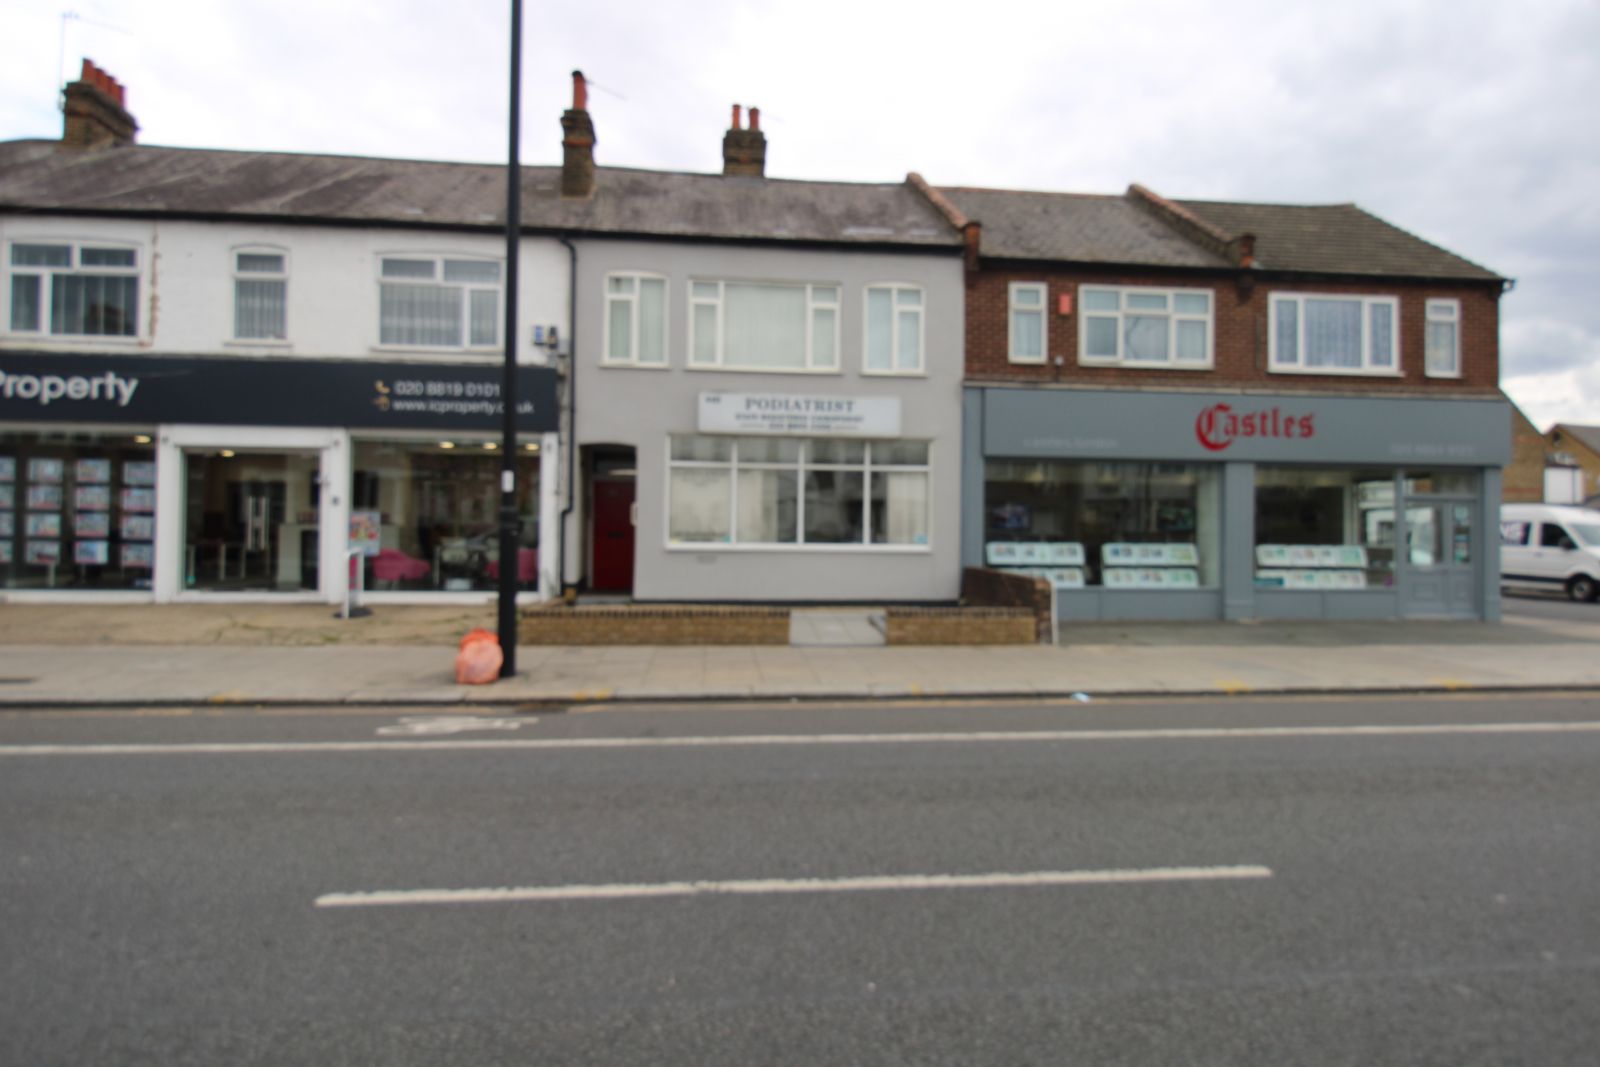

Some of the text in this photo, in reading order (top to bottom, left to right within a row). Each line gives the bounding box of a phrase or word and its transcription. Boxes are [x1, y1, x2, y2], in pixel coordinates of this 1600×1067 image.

[394, 380, 424, 396] 020
[465, 382, 500, 397] 0101
[745, 398, 853, 412] PODIATRIST
[1195, 402, 1316, 452] Castles
